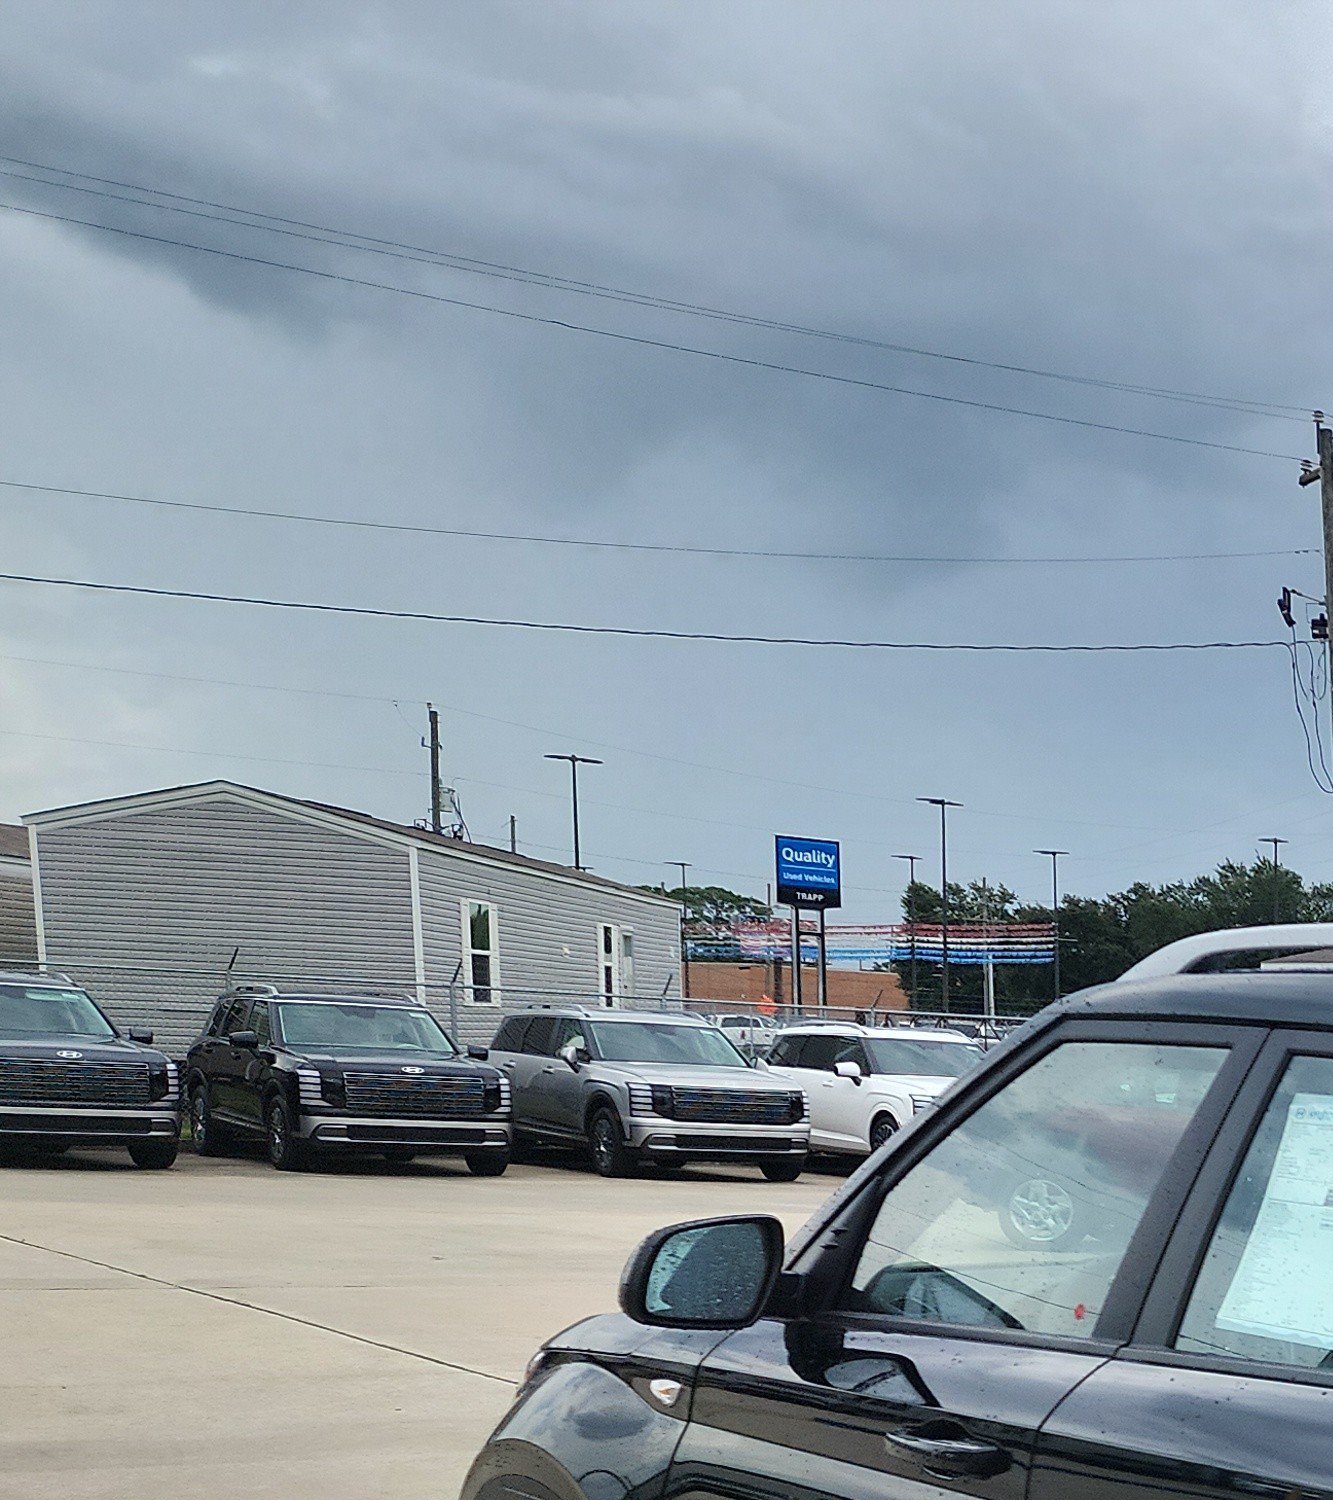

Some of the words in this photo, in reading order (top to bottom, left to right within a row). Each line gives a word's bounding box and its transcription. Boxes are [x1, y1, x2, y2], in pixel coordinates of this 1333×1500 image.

[782, 847, 835, 867] Quality
[783, 872, 802, 880] Used
[804, 873, 835, 883] Vehicles
[796, 892, 825, 901] TRAPP
